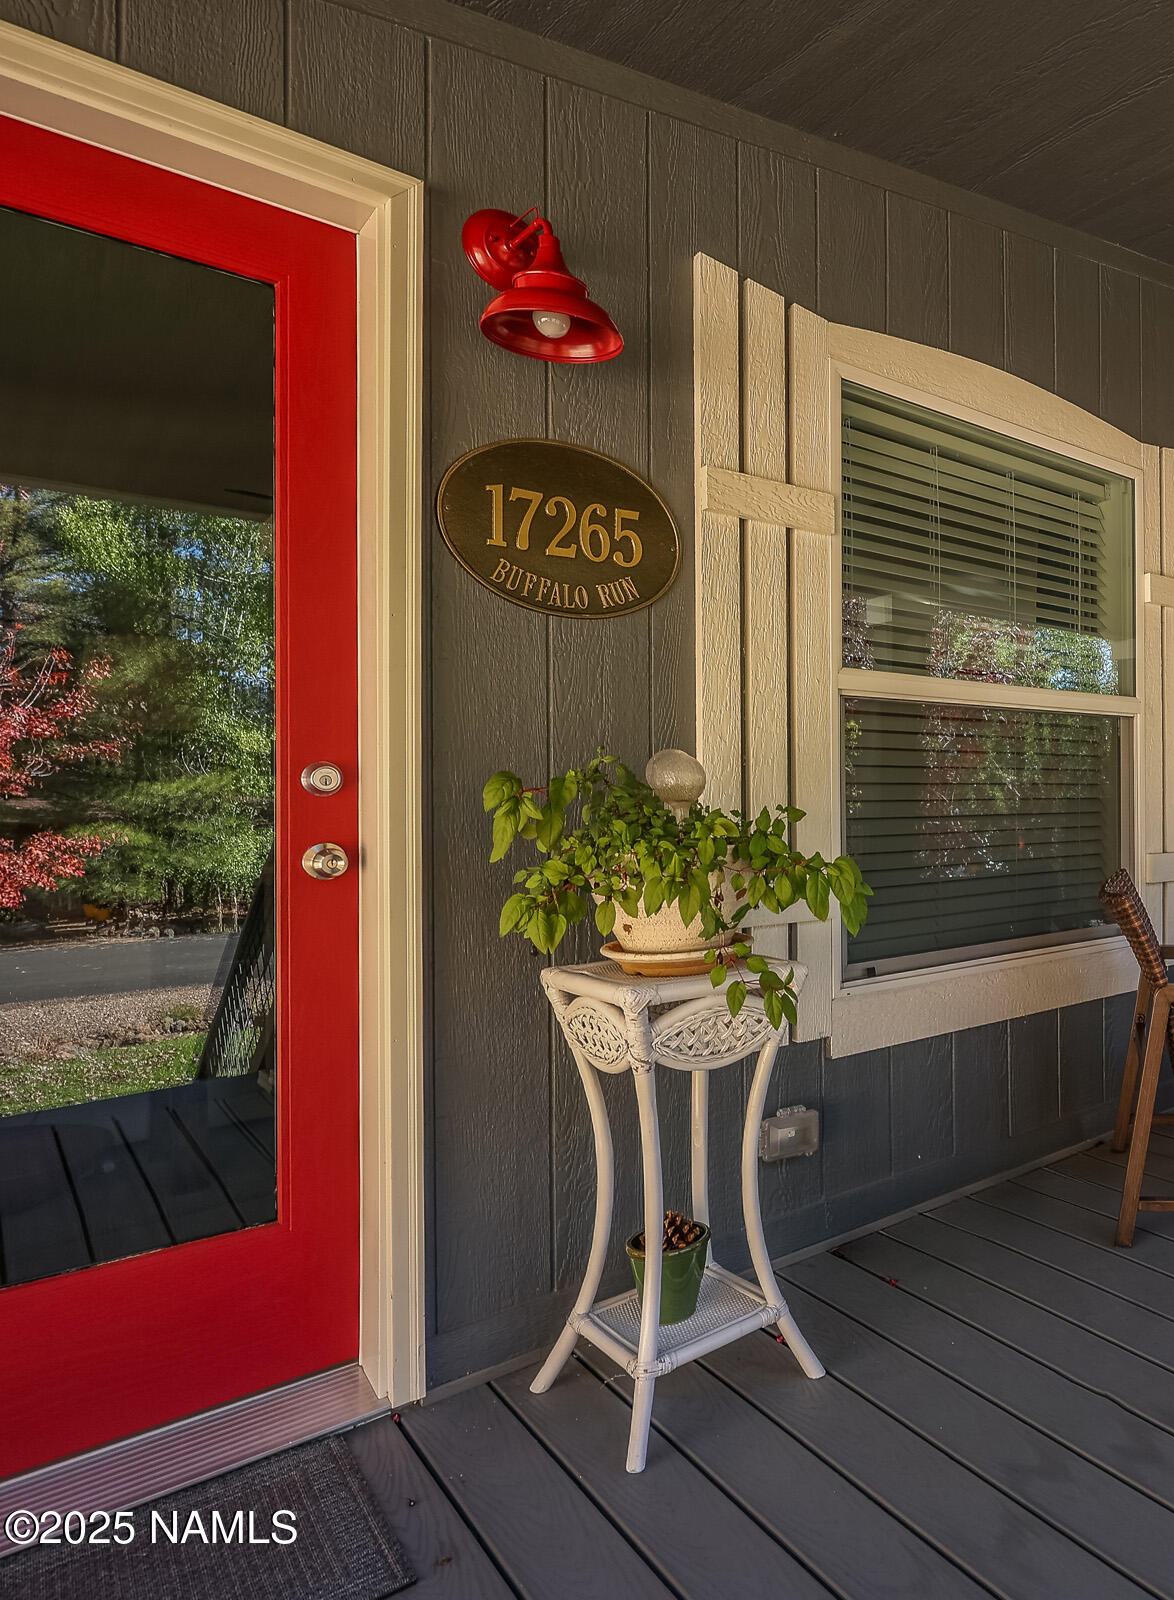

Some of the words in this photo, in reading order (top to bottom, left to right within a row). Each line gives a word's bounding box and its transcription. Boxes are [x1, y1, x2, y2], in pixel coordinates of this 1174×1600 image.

[485, 484, 643, 568] 17265
[490, 558, 589, 609] BUFFALO
[596, 576, 640, 609] RUN
